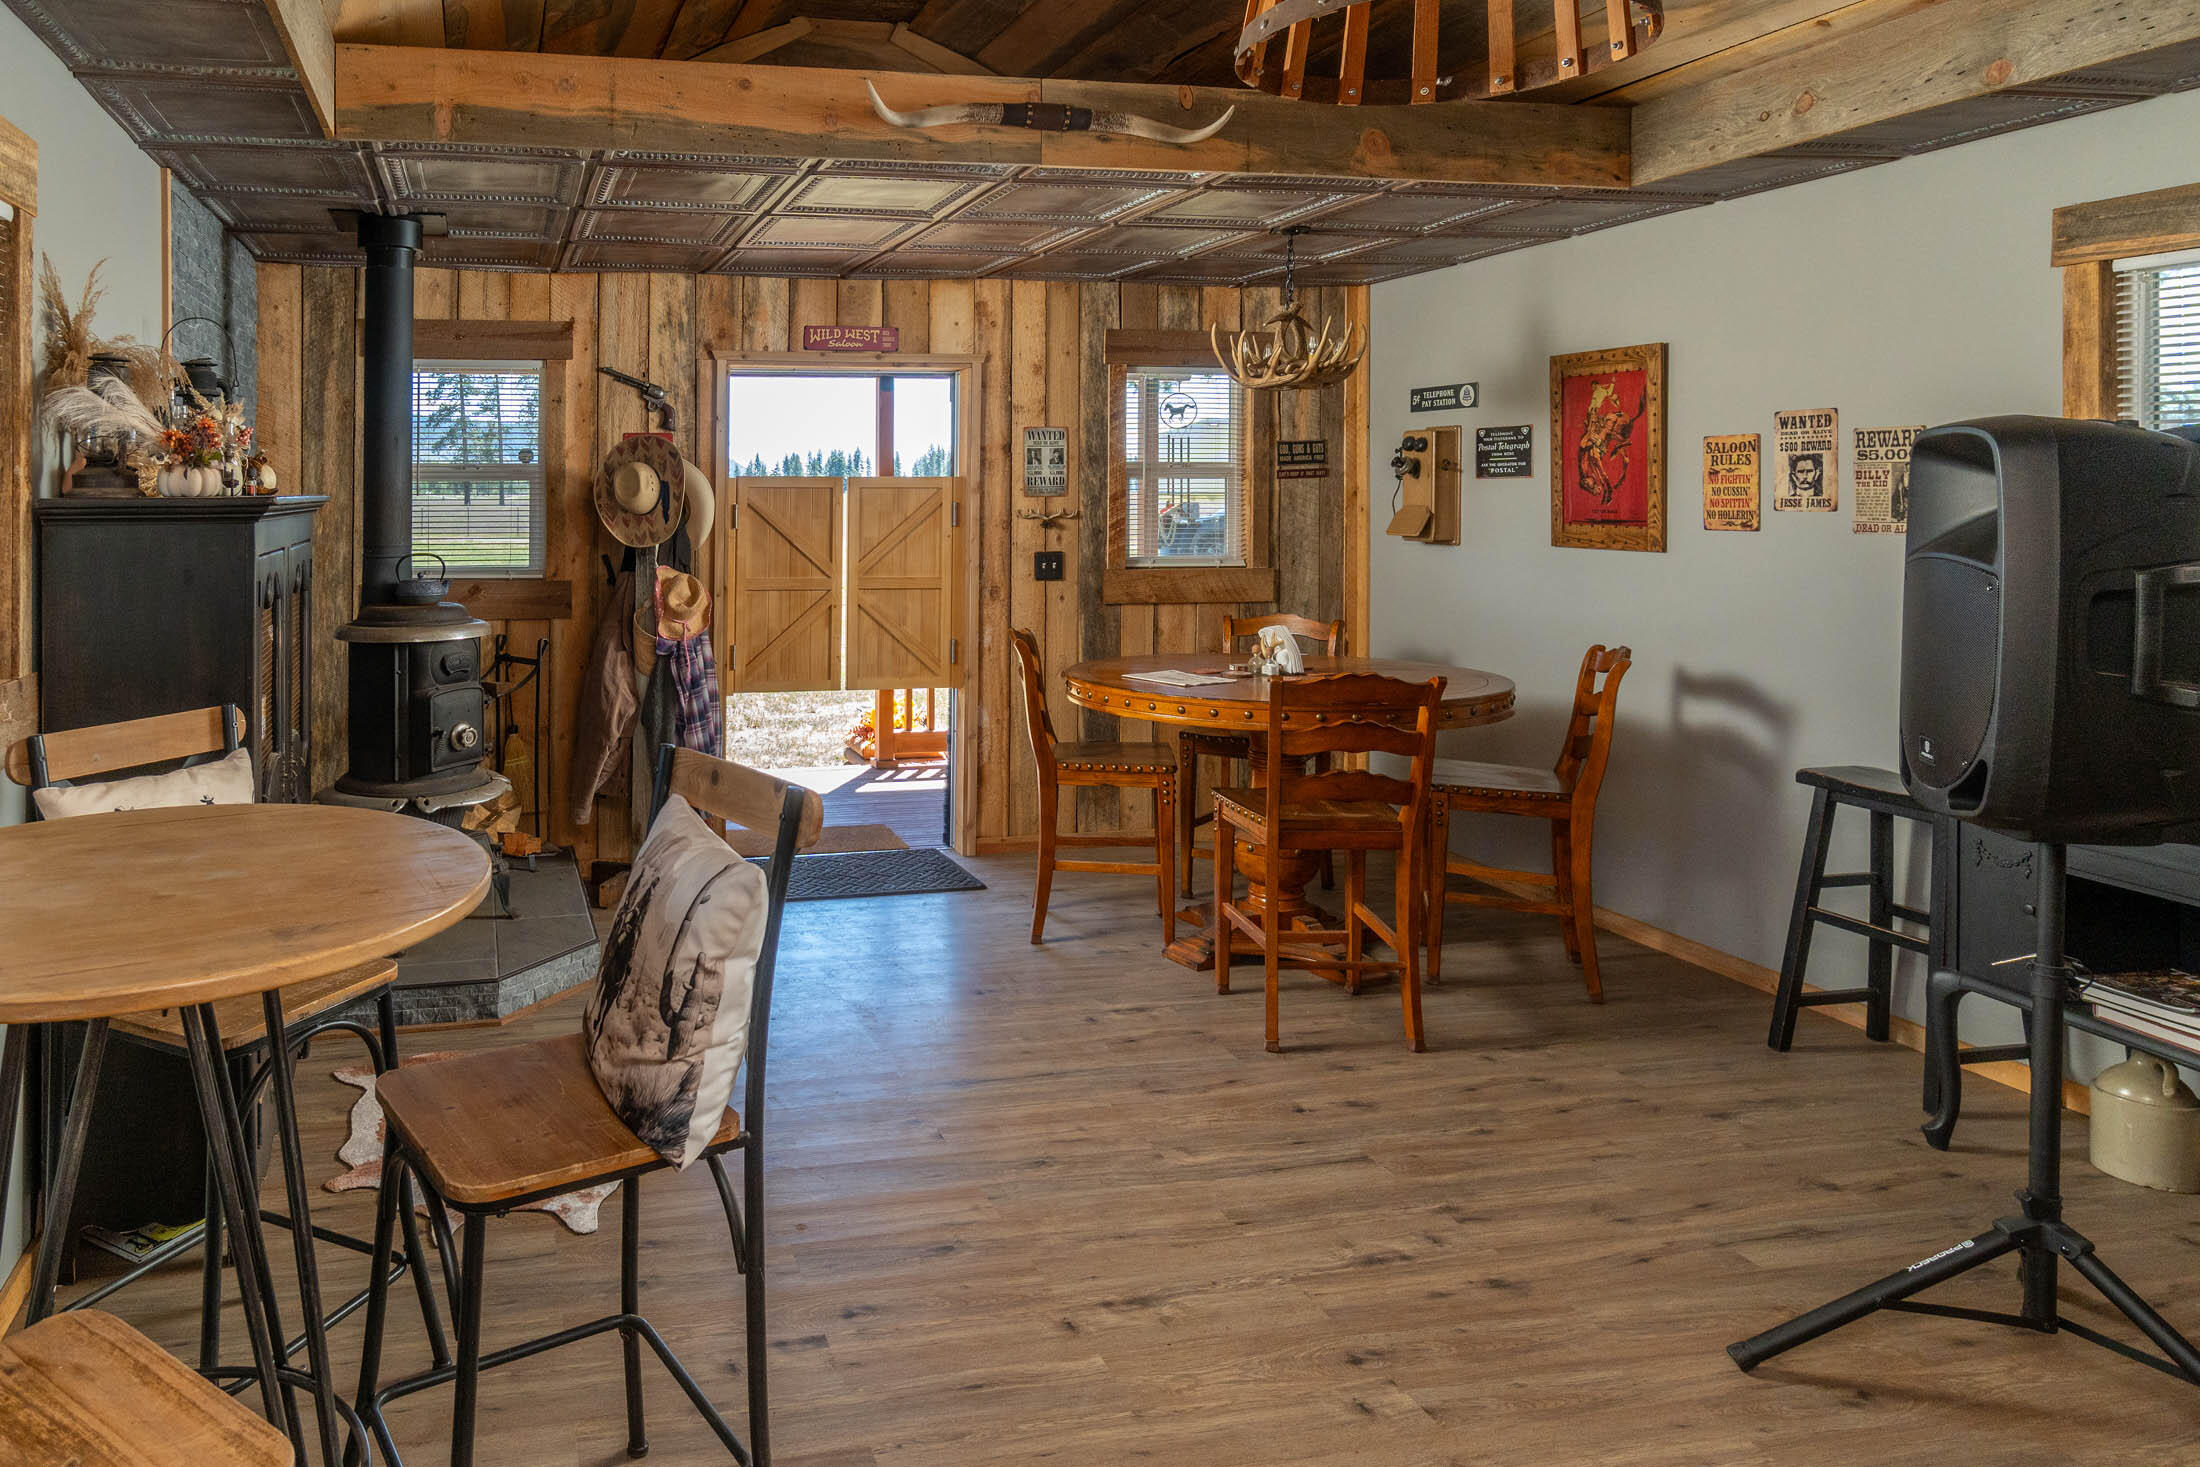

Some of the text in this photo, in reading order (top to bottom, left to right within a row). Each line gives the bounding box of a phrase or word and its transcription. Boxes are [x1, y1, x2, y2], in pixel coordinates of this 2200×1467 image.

[809, 328, 841, 344] WILD
[845, 329, 880, 344] WEST
[827, 339, 864, 348] Saloon
[1423, 389, 1455, 399] TELEPHONE
[1421, 400, 1432, 408] PAY
[1433, 398, 1456, 407] STATION
[1779, 413, 1832, 430] WANTED
[1027, 431, 1065, 440] WANTED
[1478, 440, 1530, 452] Postal Telegraph
[1705, 439, 1757, 454] SALOON
[1779, 440, 1832, 452] $500 REWARD
[1710, 453, 1752, 467] RULES
[1857, 448, 1911, 461] $5.00
[1709, 473, 1753, 485] NO FIGHTIN'
[1855, 470, 1890, 480] BILLY
[1027, 476, 1065, 486] REWARD
[1711, 486, 1750, 497] NO CUSSIN'
[1710, 498, 1752, 509] NO SPITTIN'
[1779, 498, 1832, 509] JESSE JAMES
[1706, 509, 1756, 521] NO HOLLERIN'
[1855, 523, 1879, 534] DEAD
[1881, 523, 1892, 533] OR
